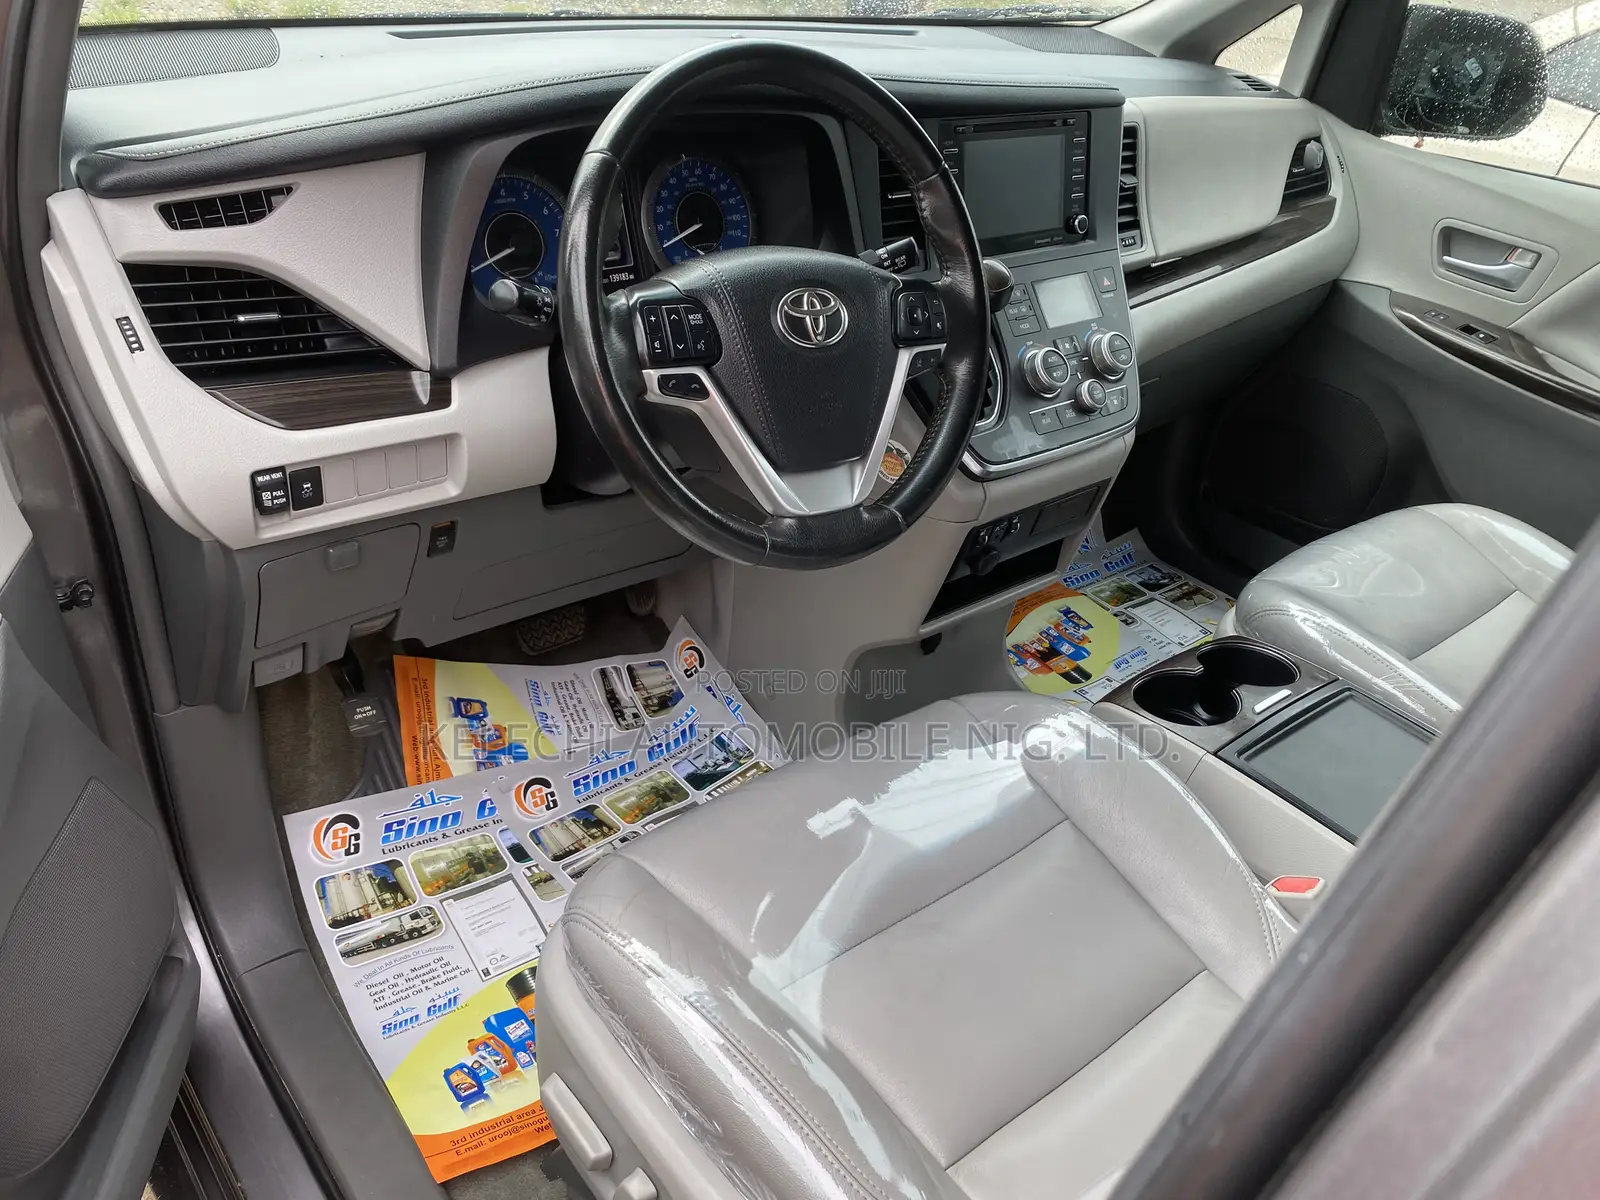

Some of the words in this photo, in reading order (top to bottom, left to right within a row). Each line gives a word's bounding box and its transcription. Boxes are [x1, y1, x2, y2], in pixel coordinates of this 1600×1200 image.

[524, 192, 529, 200] 5
[543, 207, 548, 215] 6
[554, 229, 560, 237] 7
[609, 273, 630, 282] 139183
[258, 474, 271, 482] REAR
[271, 472, 283, 480] VENT
[1062, 569, 1101, 588] Sino
[1103, 550, 1137, 572] Gulf
[424, 690, 435, 724] industrial
[529, 680, 542, 707] Sino
[538, 711, 556, 736] Gulf
[572, 759, 638, 798] Sino
[647, 716, 700, 762] Gulf
[576, 781, 622, 804] Lubricants
[624, 776, 633, 784] &
[634, 761, 662, 778] Grease
[663, 742, 697, 763] Industry
[380, 811, 464, 846] Sino
[382, 836, 439, 856] Lubricants
[442, 832, 452, 840] &
[454, 822, 490, 836] Grease
[363, 970, 378, 980] Deal
[384, 960, 394, 968] All
[394, 952, 412, 962] Kinds
[422, 944, 455, 954] Lubricants
[366, 978, 389, 990] Diesel
[393, 972, 404, 980] Oil
[410, 962, 432, 974] Motor
[433, 956, 444, 964] Oil
[369, 988, 386, 998] Gear
[405, 968, 439, 984] Hydraulic
[440, 962, 452, 970] Oil
[372, 996, 388, 1004] ATF
[421, 974, 442, 985] Brake
[375, 994, 411, 1011] Industrial
[412, 988, 424, 996] Oil
[433, 974, 458, 988] Marine
[382, 1014, 420, 1036] Sino
[426, 993, 463, 1017] Gulf
[382, 1028, 410, 1040] Lubricants
[450, 1136, 467, 1147] 3rd
[469, 1116, 515, 1139] industrial
[516, 1108, 536, 1120] area
[455, 1140, 487, 1156] E.mail:
[488, 1116, 549, 1143] urooj@sinogu
